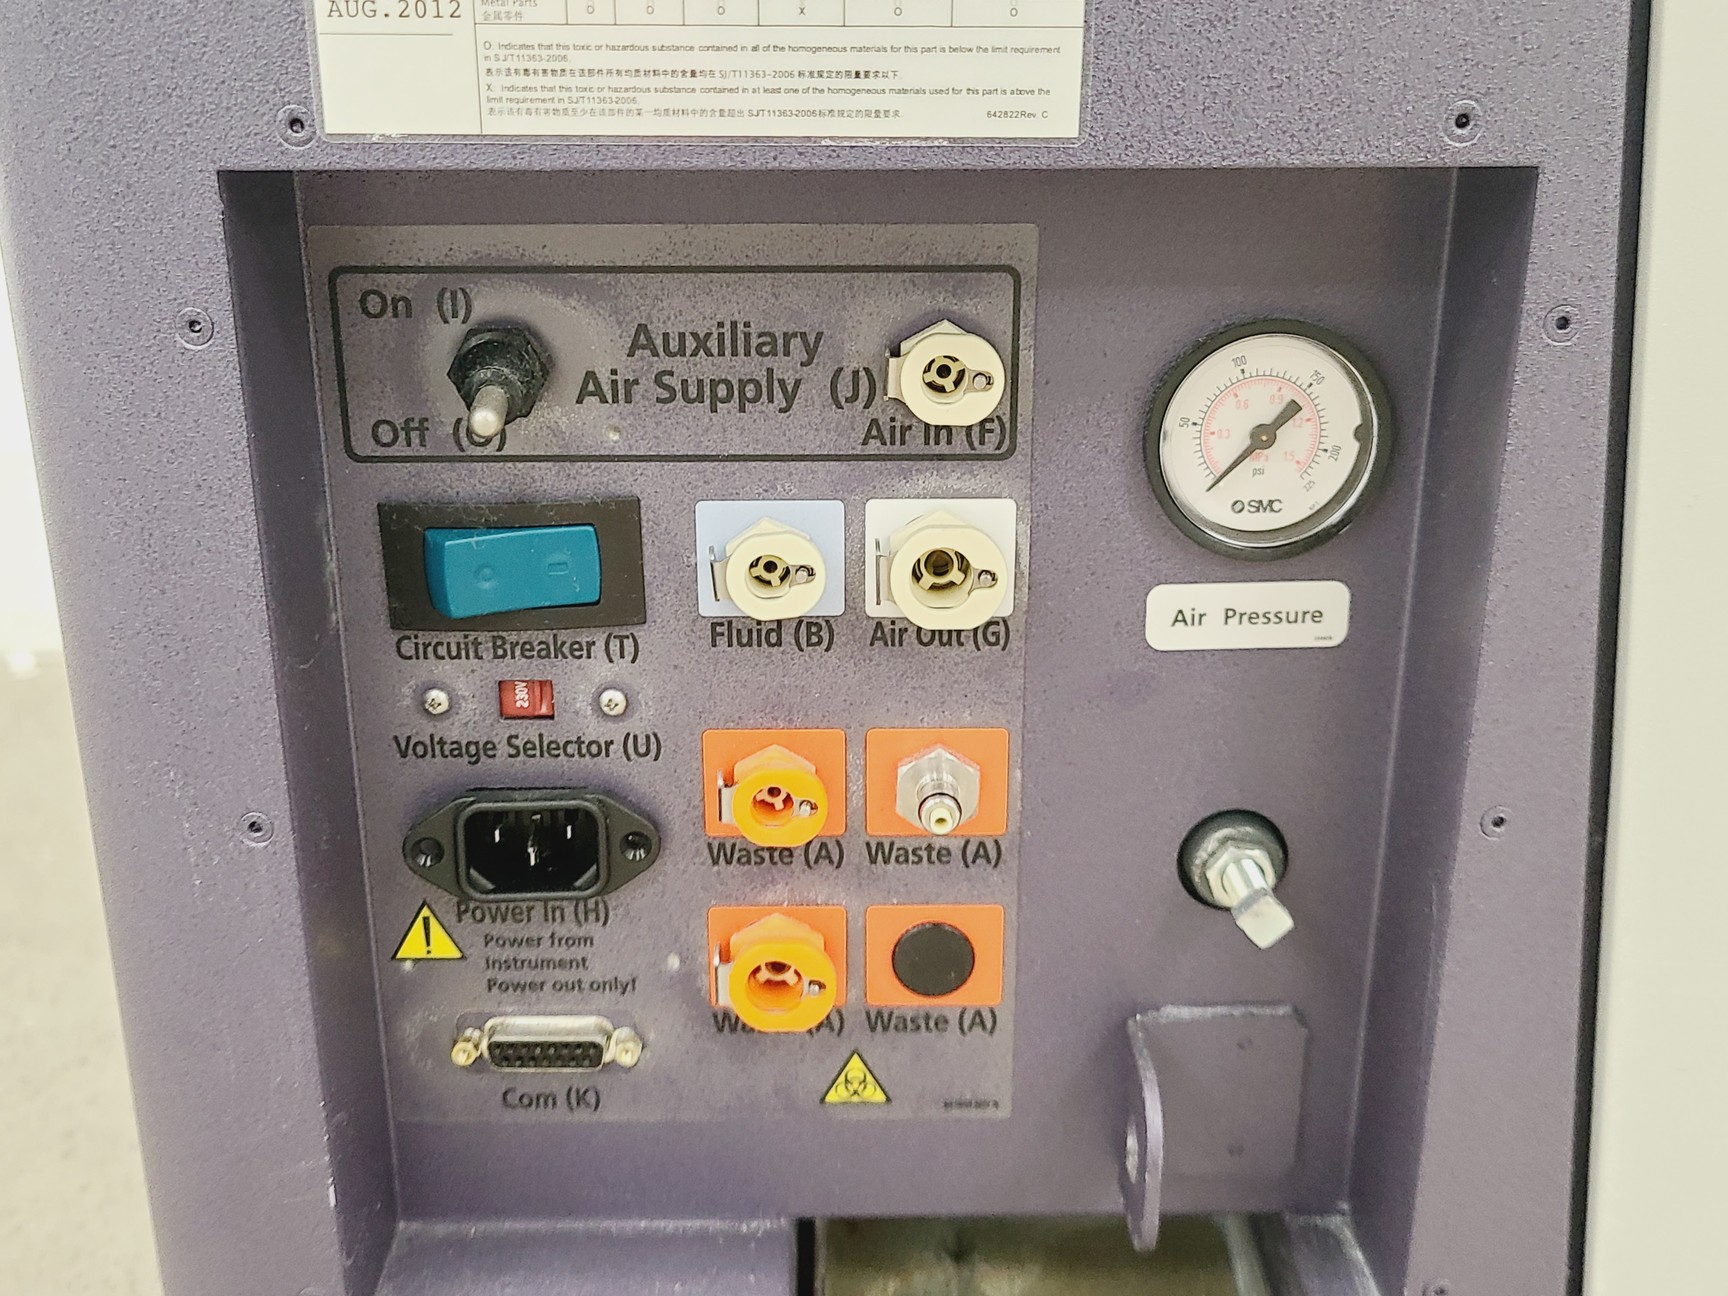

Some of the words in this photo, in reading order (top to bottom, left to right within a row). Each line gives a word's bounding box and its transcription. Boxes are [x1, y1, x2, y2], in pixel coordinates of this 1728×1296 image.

[327, 0, 461, 19] AUG.2012
[798, 6, 806, 16] X
[498, 43, 535, 51] Indicates
[538, 43, 553, 51] that
[556, 43, 570, 51] this
[606, 44, 649, 52] hazardous
[652, 44, 695, 52] substance
[699, 44, 738, 52] contained
[751, 44, 760, 52] all
[762, 44, 771, 52] of
[773, 44, 786, 52] the
[788, 45, 847, 54] homogeneous
[850, 45, 888, 53] materials
[890, 45, 902, 53] for
[904, 45, 918, 53] this
[921, 46, 937, 55] part
[949, 45, 974, 53] below
[976, 45, 989, 53] the
[991, 45, 1008, 53] limit
[1010, 46, 1060, 55] requirement
[486, 96, 504, 104] limit
[506, 96, 555, 106] requirement
[502, 85, 538, 93] Indicates
[541, 85, 556, 93] that
[559, 85, 572, 93] this
[654, 86, 696, 94] substance
[700, 86, 739, 94] contained
[742, 86, 749, 94] in
[763, 86, 781, 94] least
[812, 86, 825, 94] the
[827, 87, 886, 97] homogeneous
[889, 87, 926, 95] materials
[929, 87, 949, 95] used
[952, 87, 963, 95] for
[966, 87, 979, 95] this
[982, 88, 998, 97] part
[1001, 87, 1007, 95] is
[1010, 87, 1035, 95] above
[1038, 87, 1050, 95] the
[1041, 110, 1049, 119] C
[359, 288, 413, 319] On
[436, 287, 473, 324] (I)
[627, 323, 824, 367] Auxiliary
[1231, 355, 1248, 369] 100
[1309, 369, 1326, 386] 150
[576, 371, 639, 405] Air
[655, 369, 802, 413] Supply
[829, 366, 877, 410] (J)
[1178, 416, 1191, 428] 50
[371, 417, 429, 448] Off
[861, 417, 912, 446] Air
[965, 416, 1006, 451] (F)
[1327, 444, 1343, 463] 200
[1252, 467, 1265, 478] psi
[1247, 499, 1283, 514] SMC
[1171, 608, 1207, 627] Air
[1224, 607, 1323, 626] Pressure
[710, 620, 783, 648] Fluid
[793, 617, 835, 651] (B)
[869, 619, 909, 648] Air
[972, 616, 1011, 651] (G)
[395, 635, 484, 660] Circuit
[492, 635, 596, 660] Breaker
[604, 632, 640, 663] (T)
[514, 680, 530, 709] 230V
[393, 734, 497, 765] Voltage
[506, 732, 614, 759] Selector
[622, 731, 662, 762] (U)
[706, 841, 794, 866] Waste
[803, 839, 845, 869] (A)
[866, 842, 953, 866] Waste
[961, 839, 1002, 869] (A)
[456, 900, 534, 924] Power
[543, 900, 565, 923] In
[573, 898, 610, 927] (H)
[484, 932, 543, 949] Power
[550, 931, 594, 949] from
[485, 954, 589, 971] Instrument
[486, 976, 545, 993] Power
[551, 977, 585, 992] out
[866, 1009, 949, 1034] Waste
[957, 1007, 998, 1036] (A)
[502, 1087, 557, 1110] Com
[566, 1085, 601, 1112] (K)
